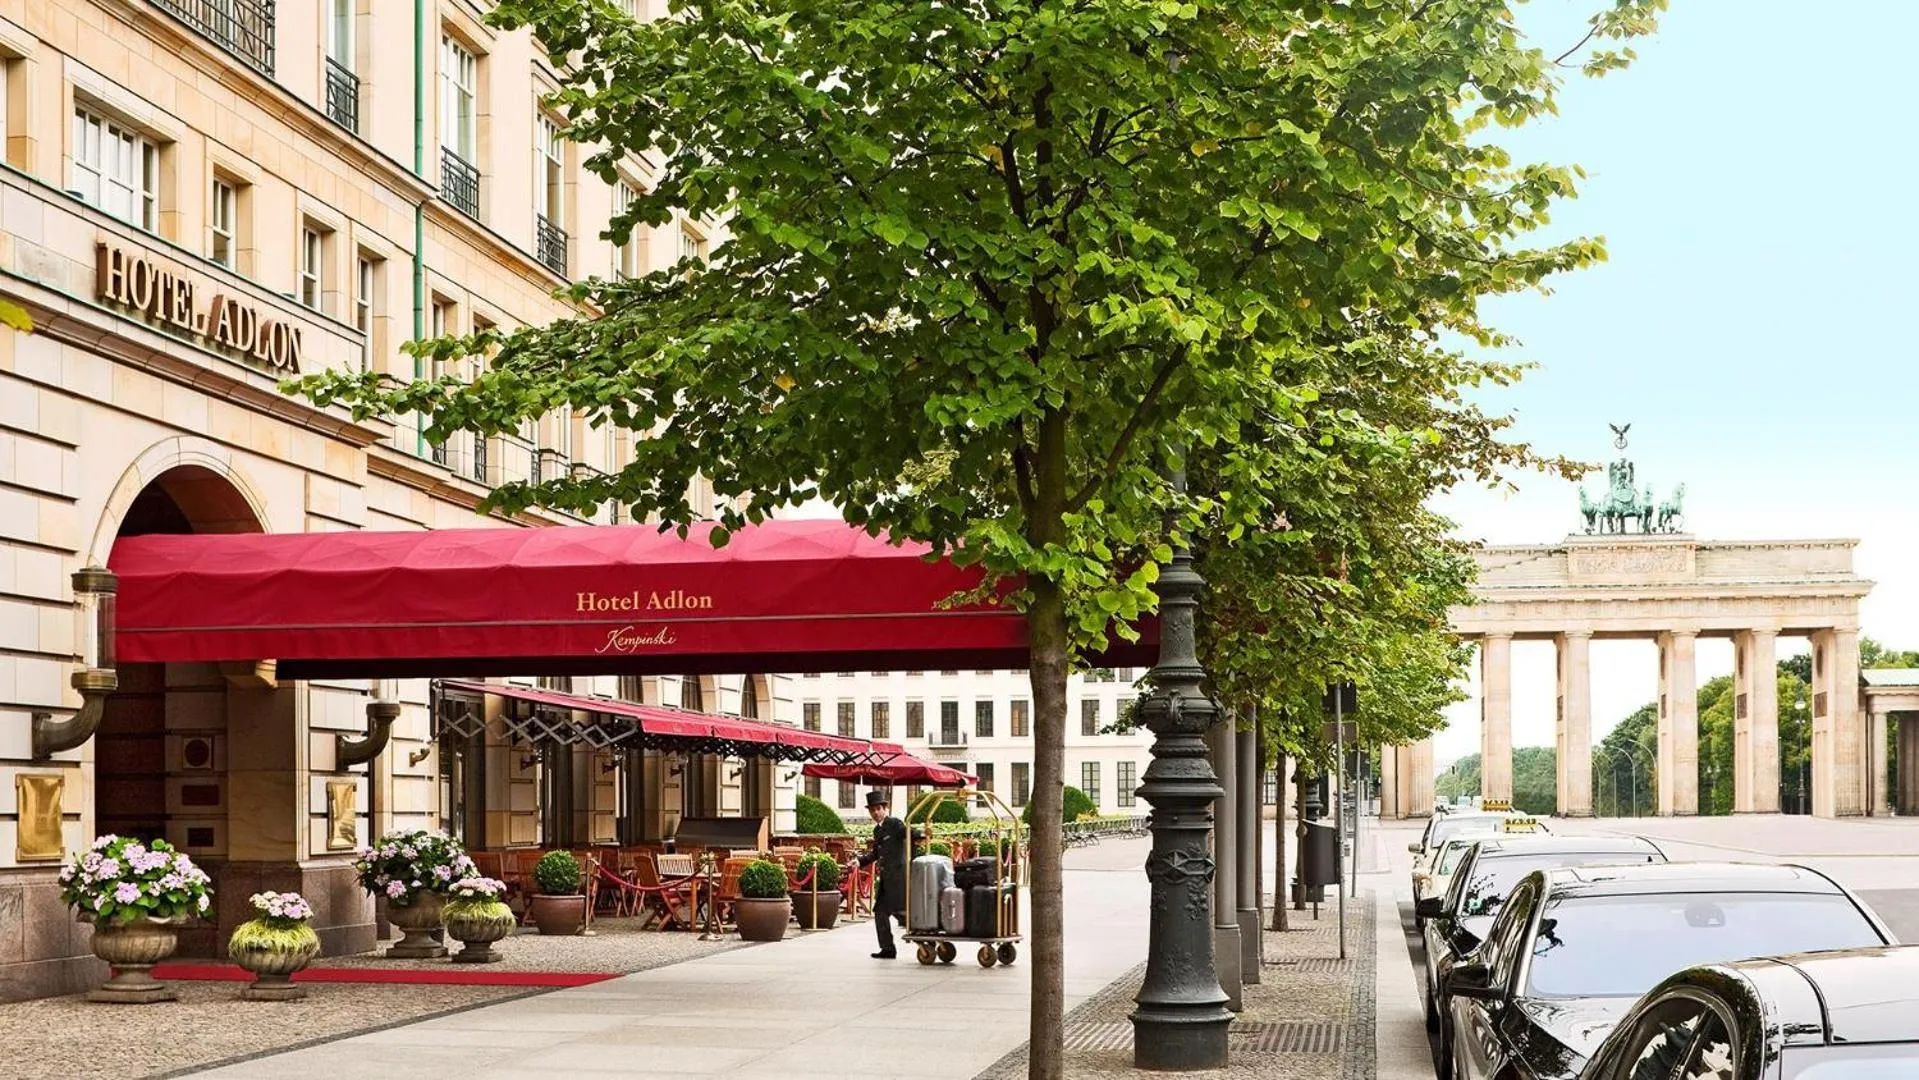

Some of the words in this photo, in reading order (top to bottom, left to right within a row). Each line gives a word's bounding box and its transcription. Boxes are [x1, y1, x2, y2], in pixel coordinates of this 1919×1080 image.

[98, 243, 209, 336] HOTEL
[211, 294, 302, 374] ADLON
[576, 591, 639, 612] Hotel
[646, 590, 713, 610] Adlon
[594, 625, 676, 654] Kempinski
